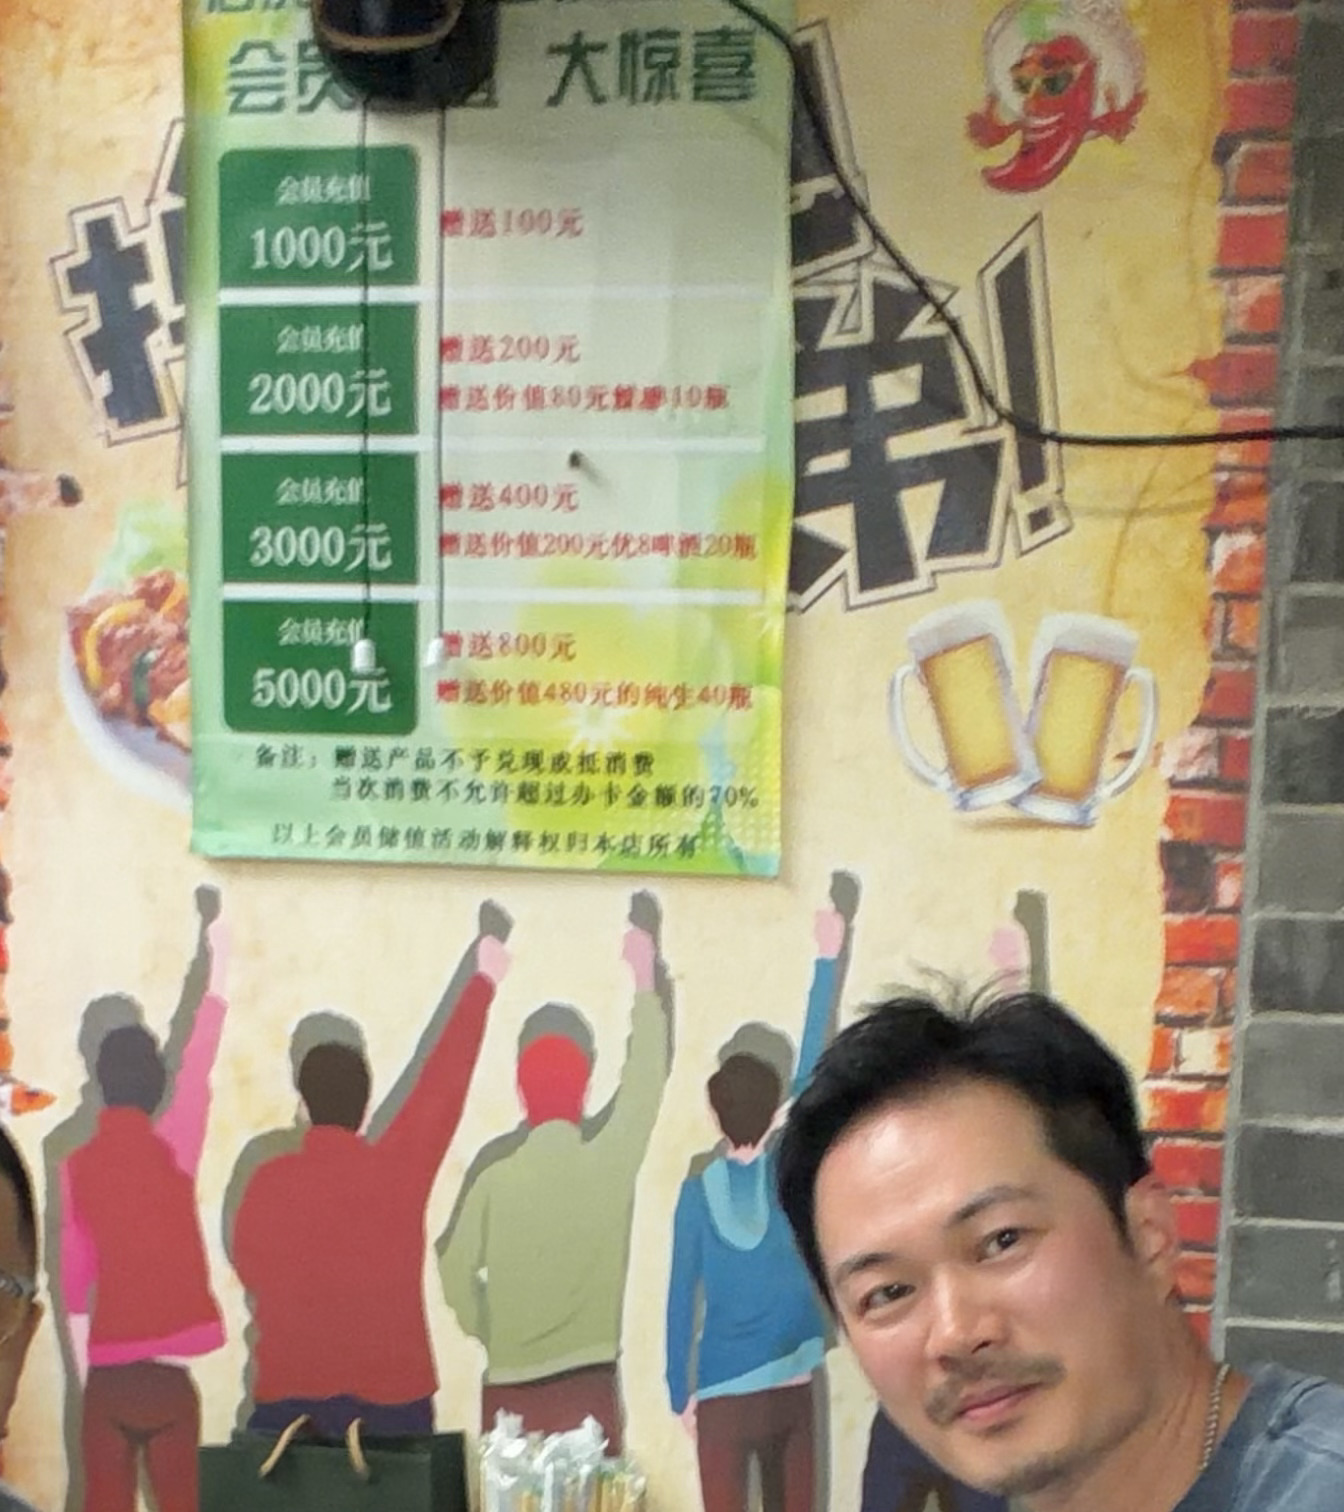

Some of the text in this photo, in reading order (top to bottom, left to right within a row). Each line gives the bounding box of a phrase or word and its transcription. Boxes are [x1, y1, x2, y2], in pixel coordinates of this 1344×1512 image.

[547, 27, 756, 106] 大惊喜
[250, 220, 394, 274] 1000元
[440, 207, 583, 239] 赠送100元
[439, 334, 582, 364] 赠送200元
[248, 367, 392, 419] 2000元
[440, 482, 579, 512] 赠送400元
[248, 521, 393, 573] 3000元
[251, 666, 393, 716] 5000元
